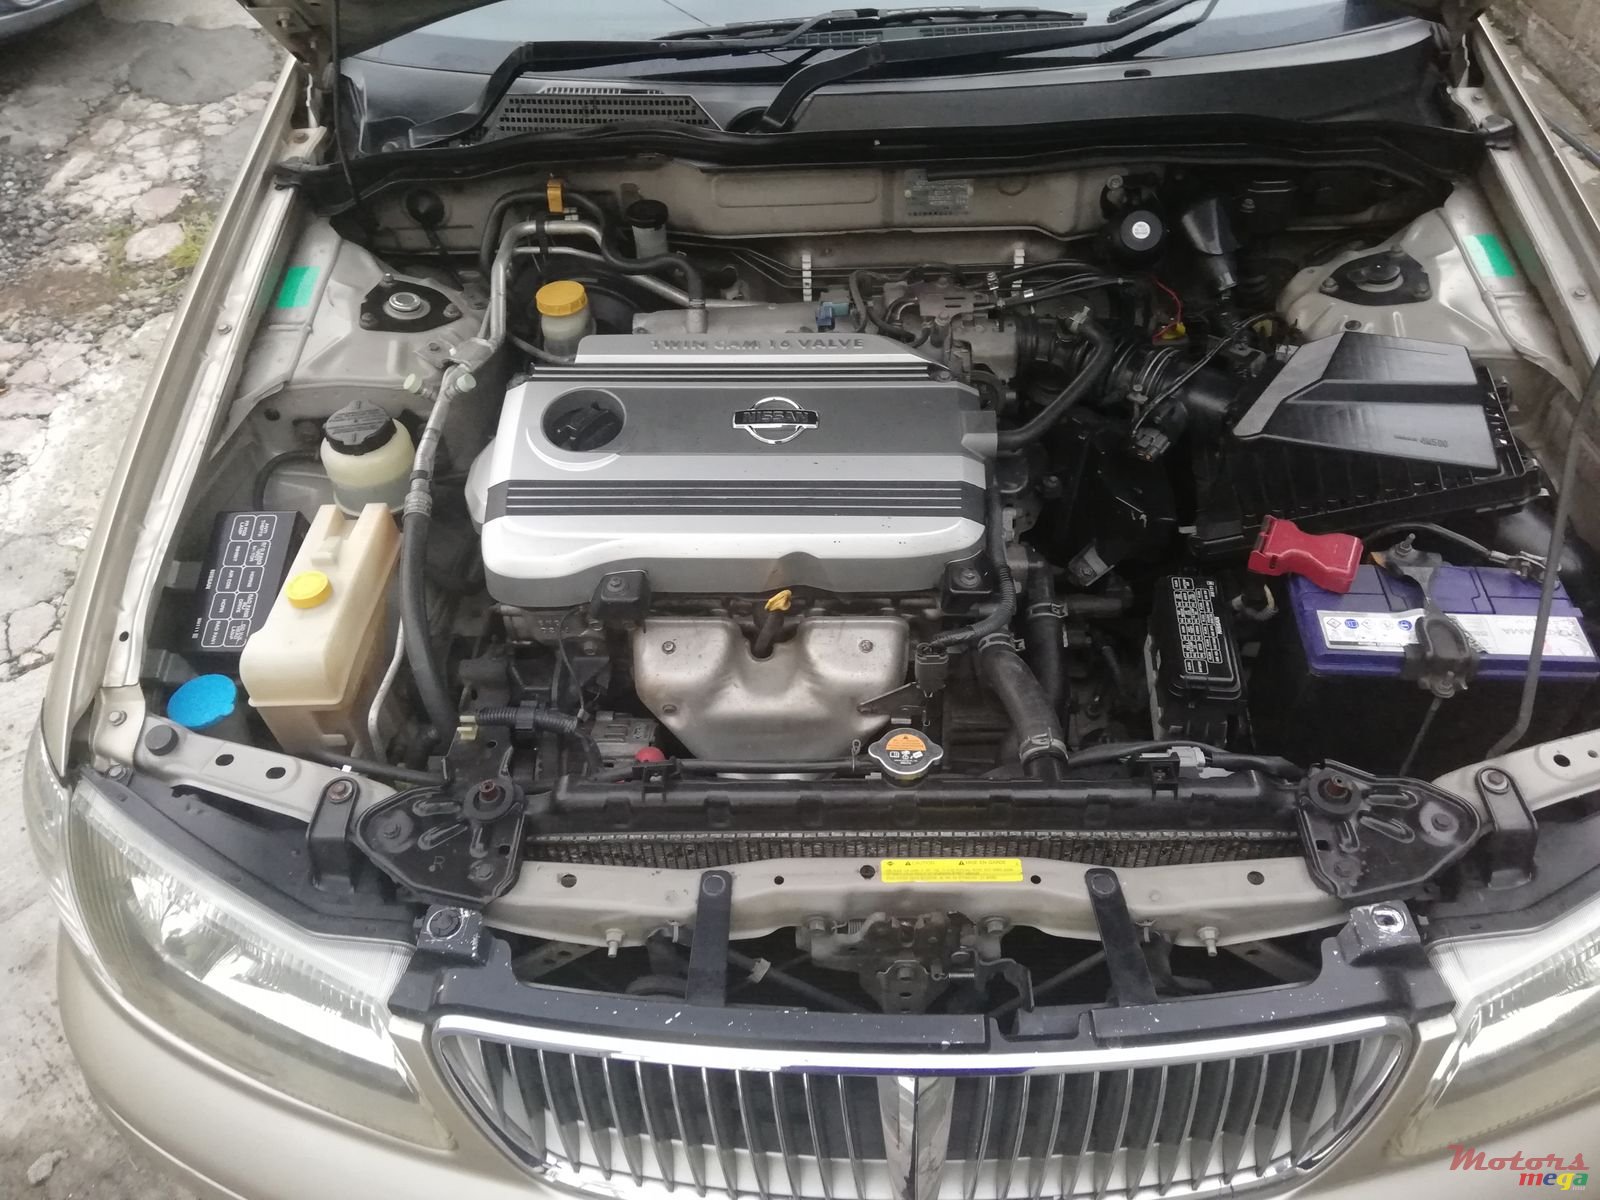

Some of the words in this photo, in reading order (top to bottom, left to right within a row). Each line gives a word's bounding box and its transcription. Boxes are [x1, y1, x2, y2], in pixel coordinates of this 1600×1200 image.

[652, 338, 707, 350] TWIN
[714, 338, 760, 350] CAM
[769, 338, 791, 350] 16
[798, 338, 864, 349] VALVE
[743, 411, 809, 423] NISSAN
